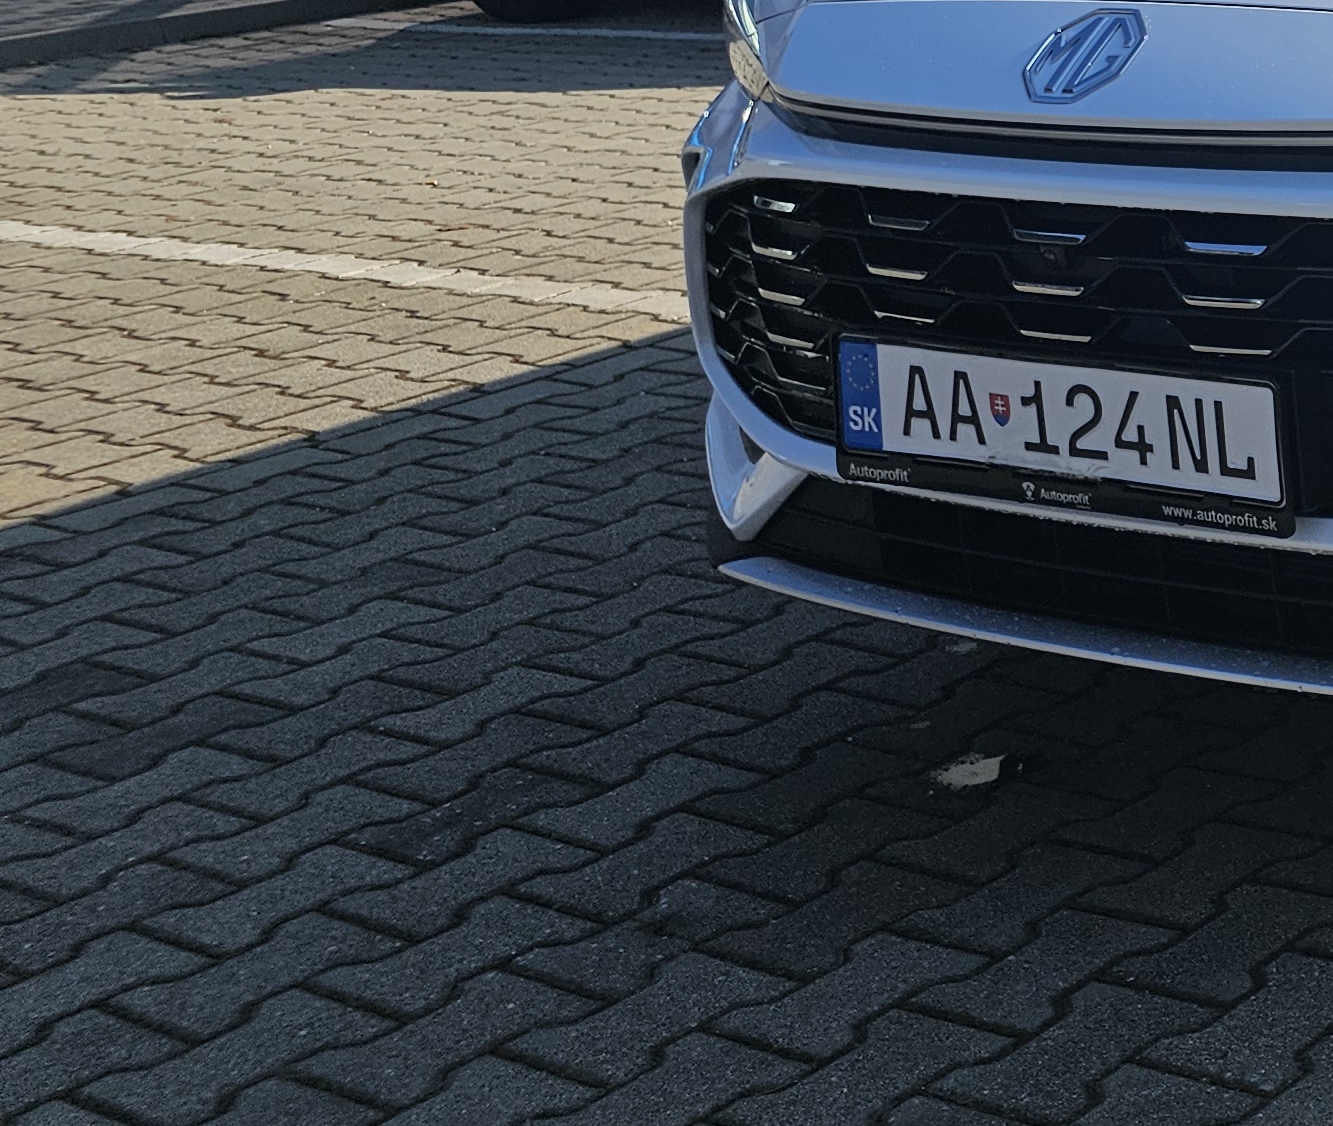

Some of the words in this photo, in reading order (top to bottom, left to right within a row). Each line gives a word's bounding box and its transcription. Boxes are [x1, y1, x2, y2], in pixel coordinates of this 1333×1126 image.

[1033, 15, 1137, 94] MG
[848, 405, 879, 433] SK
[1162, 504, 1278, 531] www.autoprofit.sk
